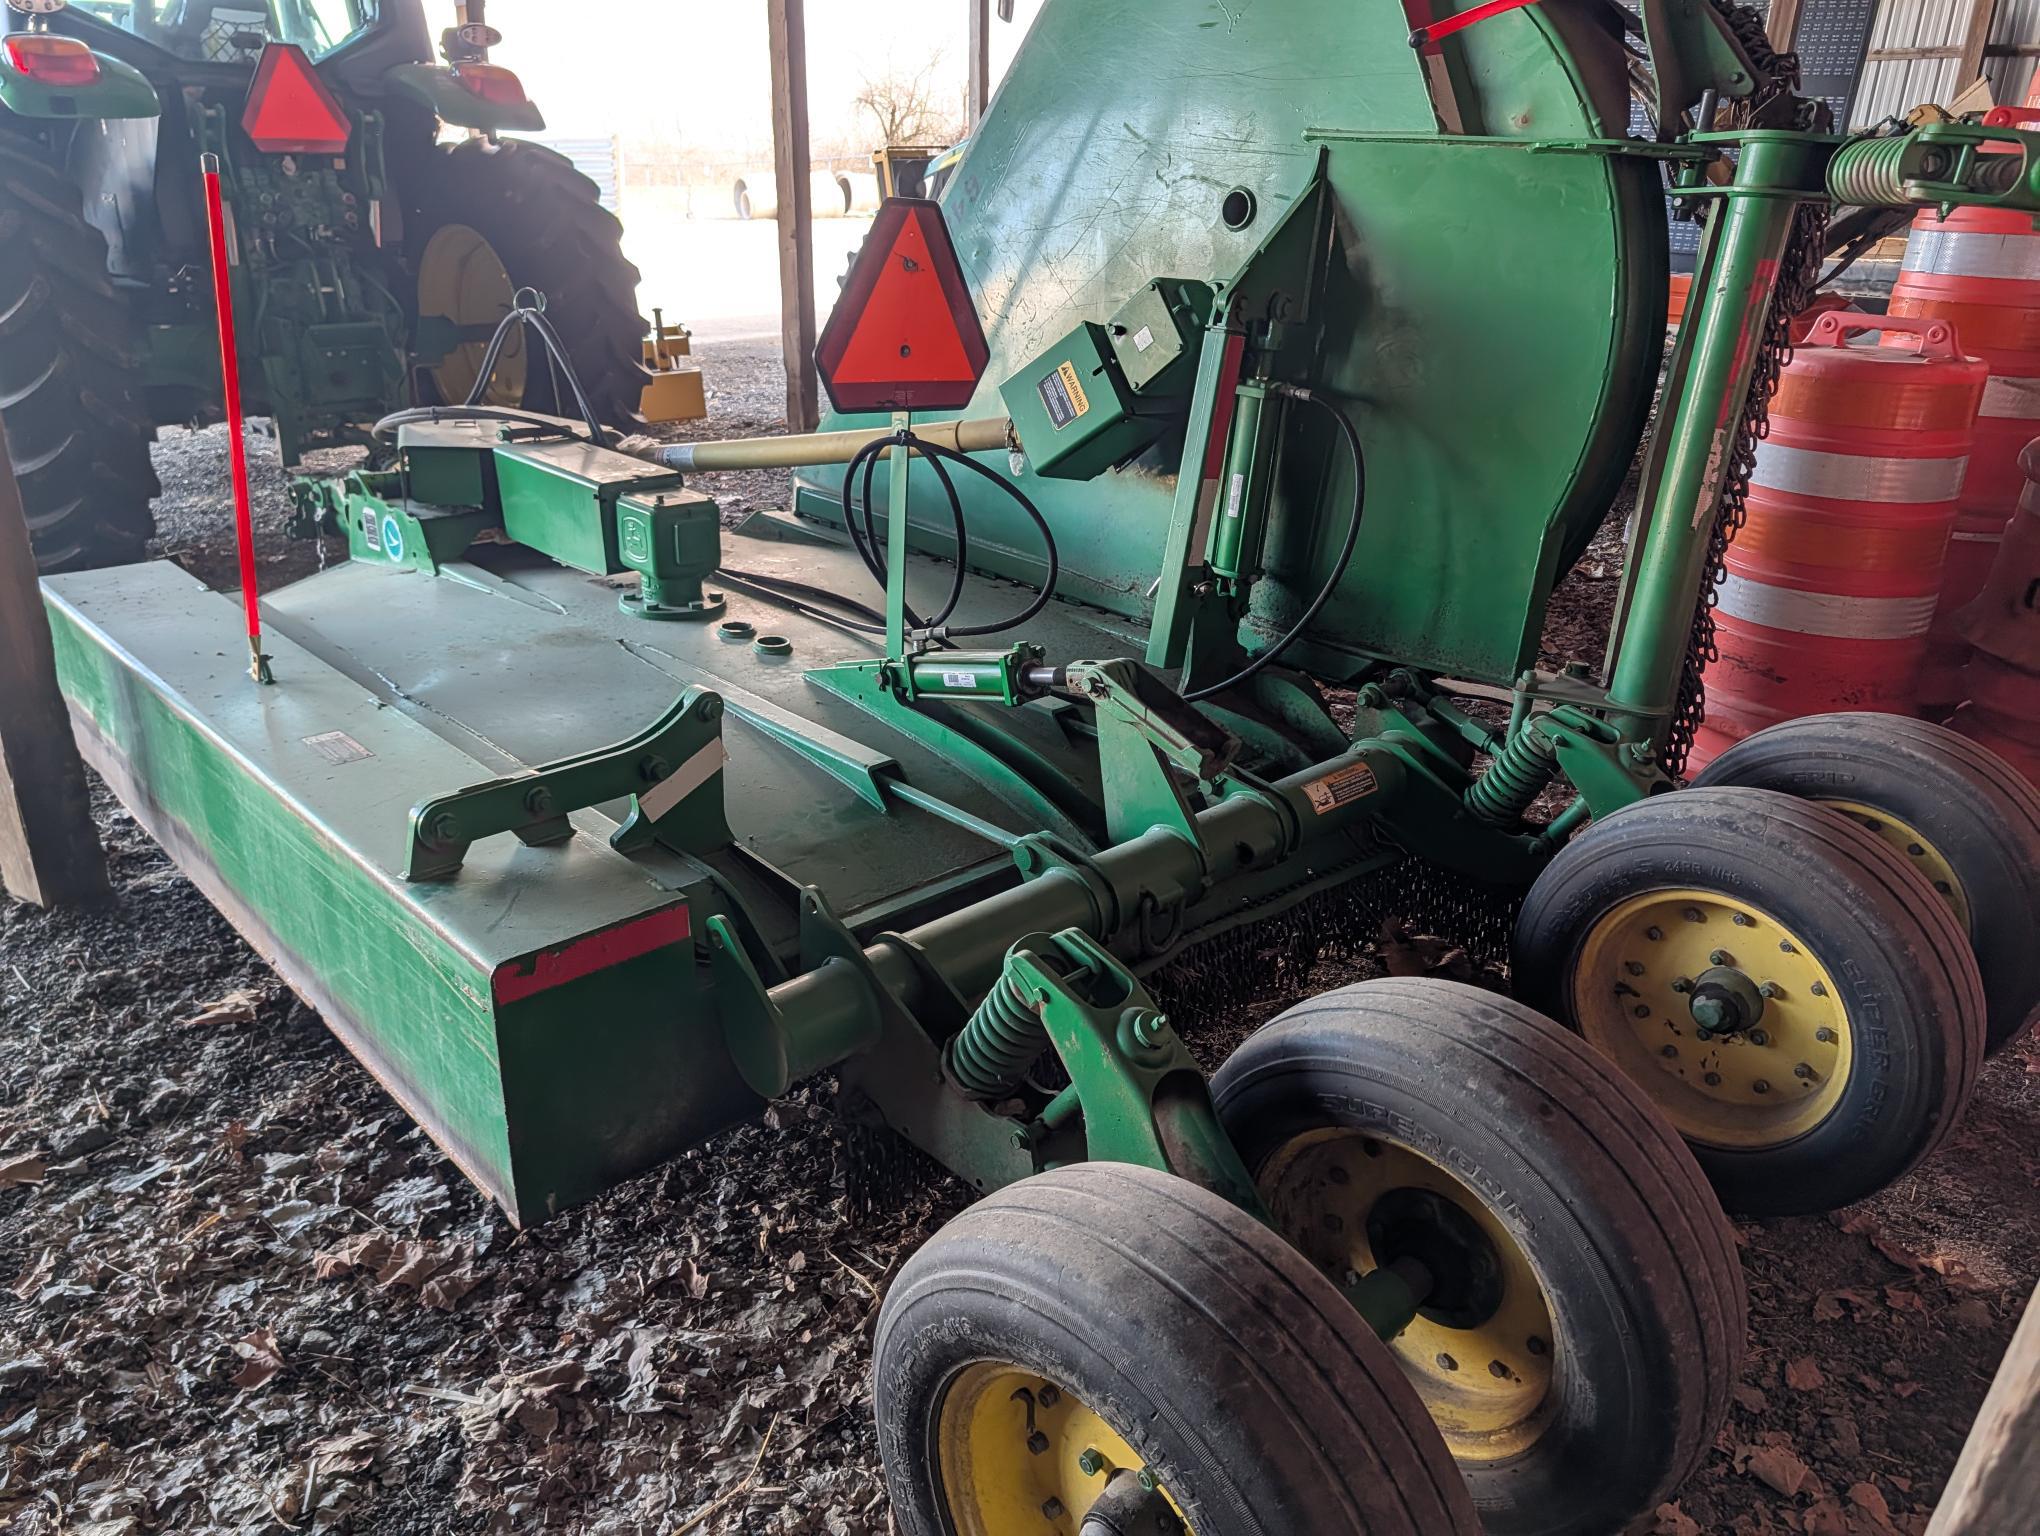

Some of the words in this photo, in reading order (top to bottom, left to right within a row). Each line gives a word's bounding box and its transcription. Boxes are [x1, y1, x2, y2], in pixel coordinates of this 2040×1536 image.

[1066, 374, 1086, 411] WARNING
[1841, 959, 1891, 1072] SUPER
[1316, 1093, 1441, 1154] SUPER
[1446, 1147, 1537, 1233] GRIP
